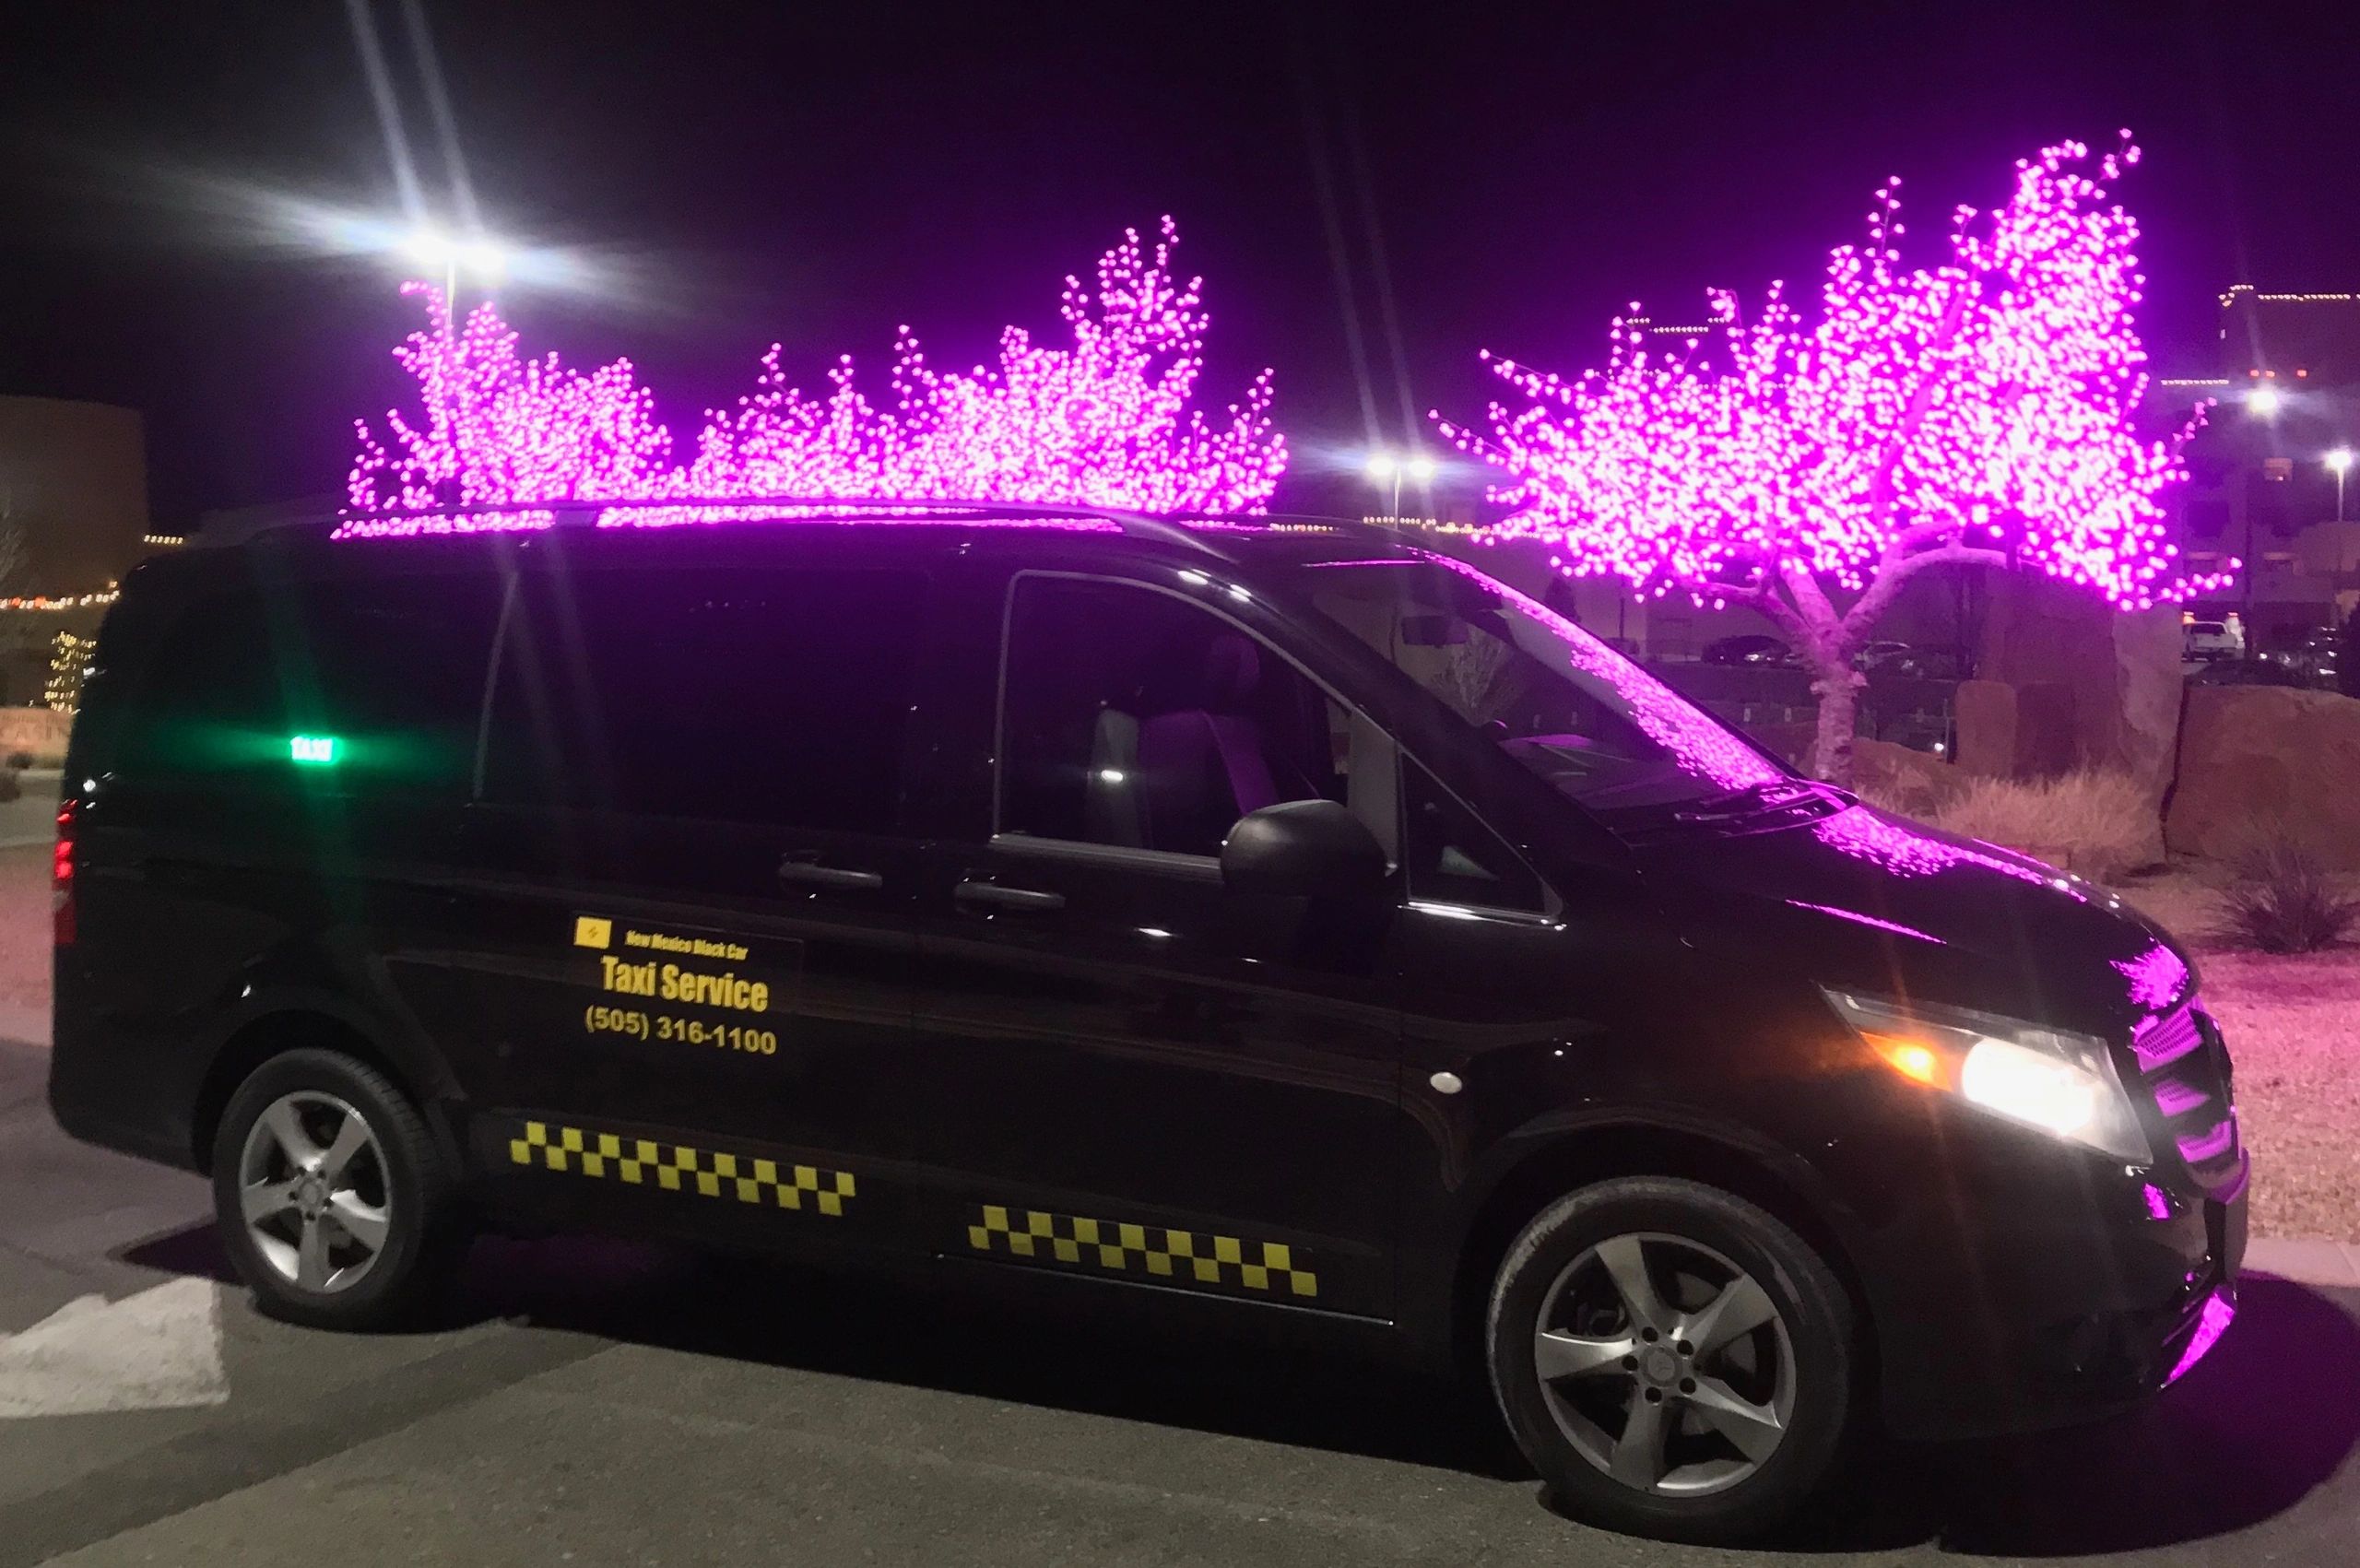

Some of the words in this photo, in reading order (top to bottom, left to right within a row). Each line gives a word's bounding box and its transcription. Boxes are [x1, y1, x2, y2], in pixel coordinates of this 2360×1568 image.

[625, 929, 651, 948] New
[651, 933, 691, 953] Mexico
[727, 943, 749, 961] Car
[601, 955, 656, 996] Taxi
[661, 963, 769, 1012] Service
[585, 1005, 649, 1041] (505)
[657, 1016, 777, 1055] 316-1100
